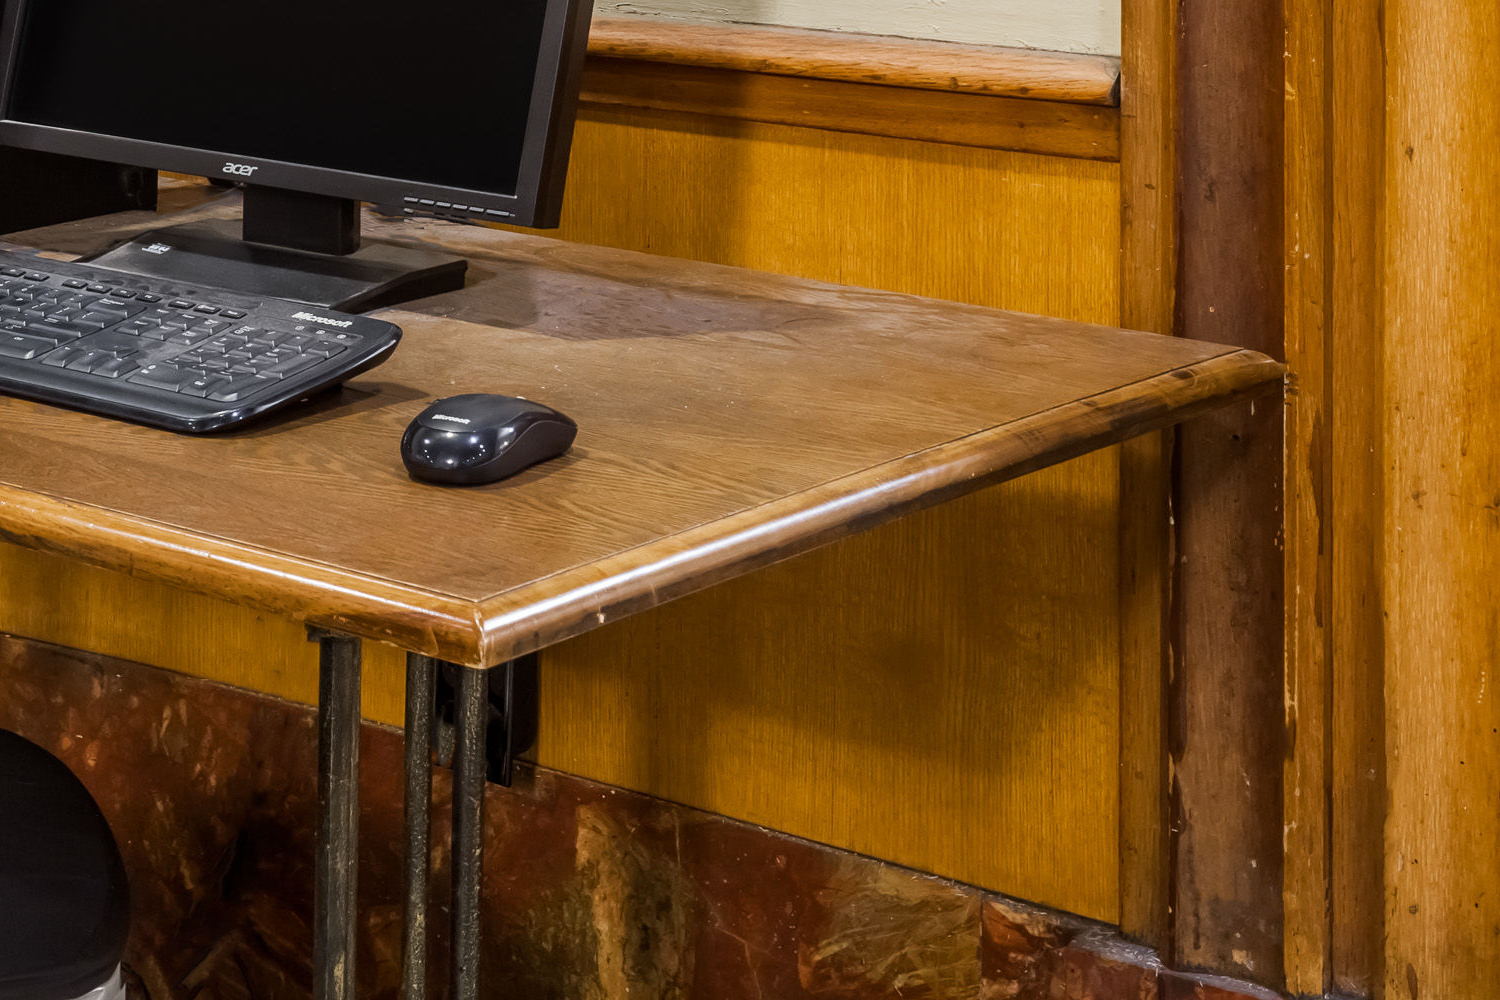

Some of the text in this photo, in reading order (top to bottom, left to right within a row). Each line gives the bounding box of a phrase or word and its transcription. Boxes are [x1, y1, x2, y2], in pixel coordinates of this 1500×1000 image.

[222, 162, 258, 176] acer
[291, 311, 353, 328] Microsoft
[431, 414, 471, 425] Microsoft
